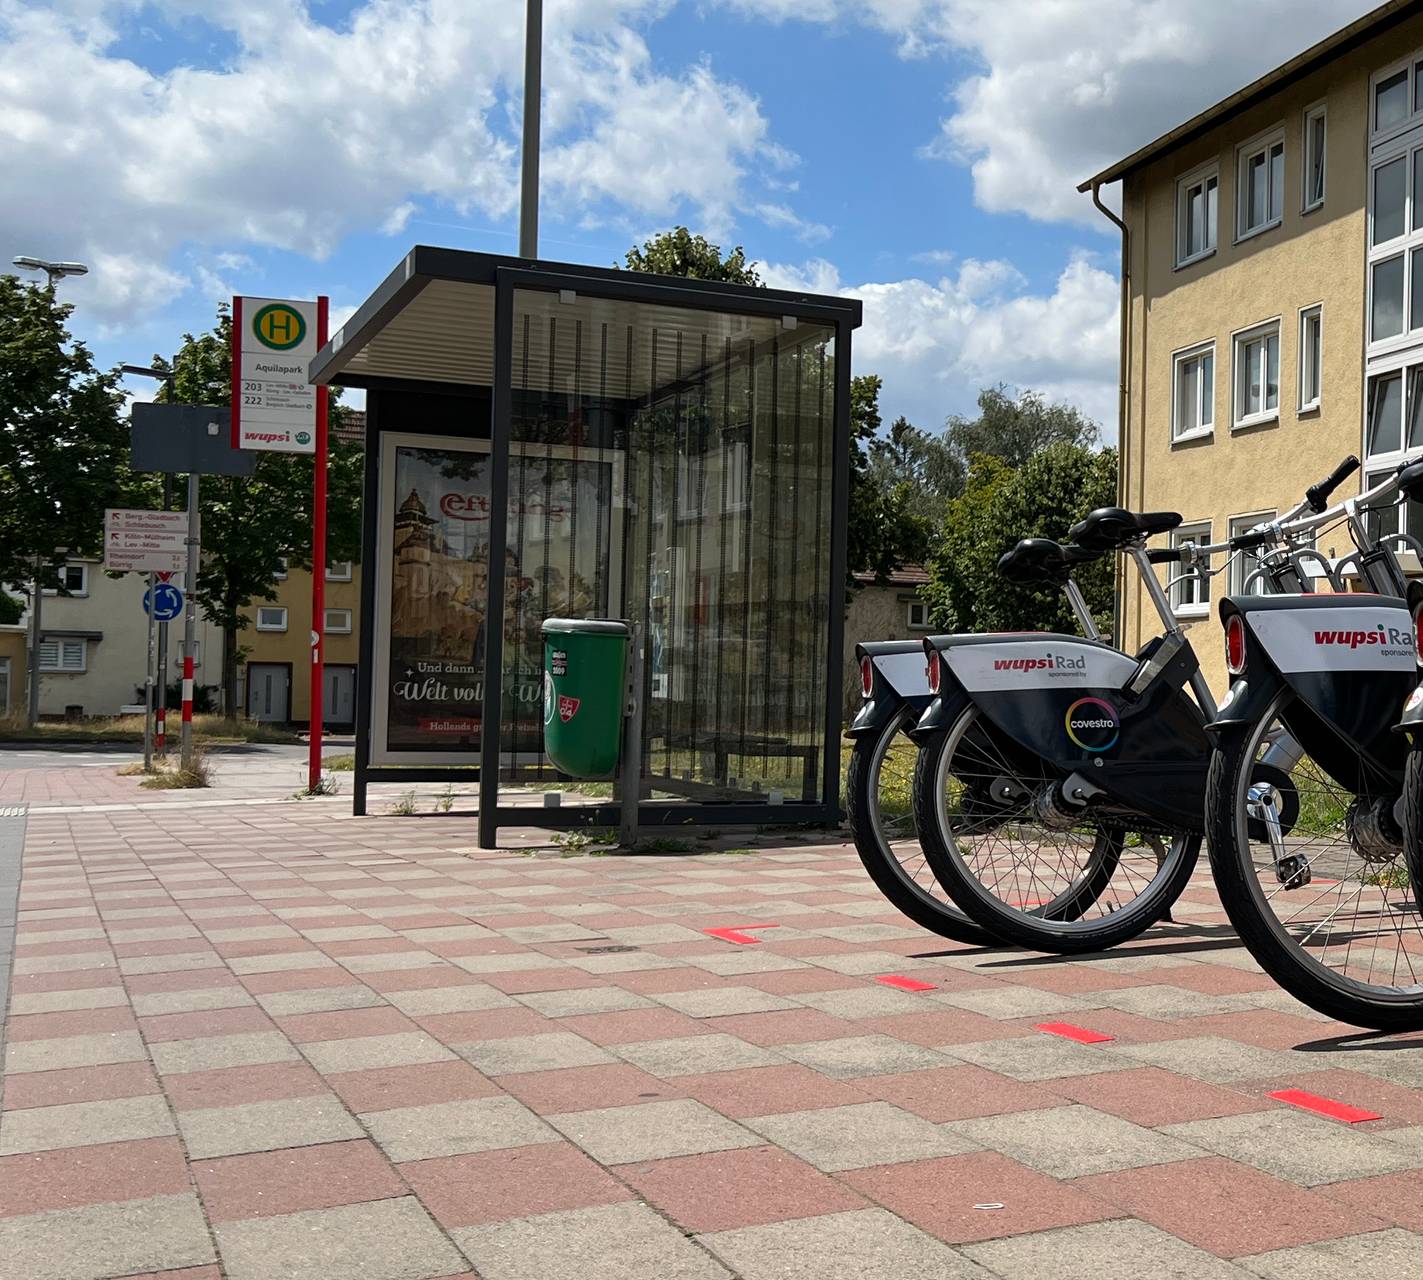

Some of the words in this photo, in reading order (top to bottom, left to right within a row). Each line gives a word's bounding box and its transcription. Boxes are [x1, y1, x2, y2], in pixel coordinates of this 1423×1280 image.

[269, 313, 291, 340] H
[255, 363, 303, 375] Aquilapark
[244, 382, 262, 391] 203
[244, 396, 262, 405] 222
[244, 430, 290, 443] wupsi
[1314, 623, 1387, 649] wupsi
[1388, 628, 1413, 645] Ra
[417, 662, 442, 673] Und
[445, 662, 475, 674] dann
[994, 653, 1054, 672] wupsi
[1055, 656, 1086, 669] Rad
[393, 677, 451, 701] Welt
[430, 721, 471, 731] Hollands
[1070, 719, 1114, 728] covestro
